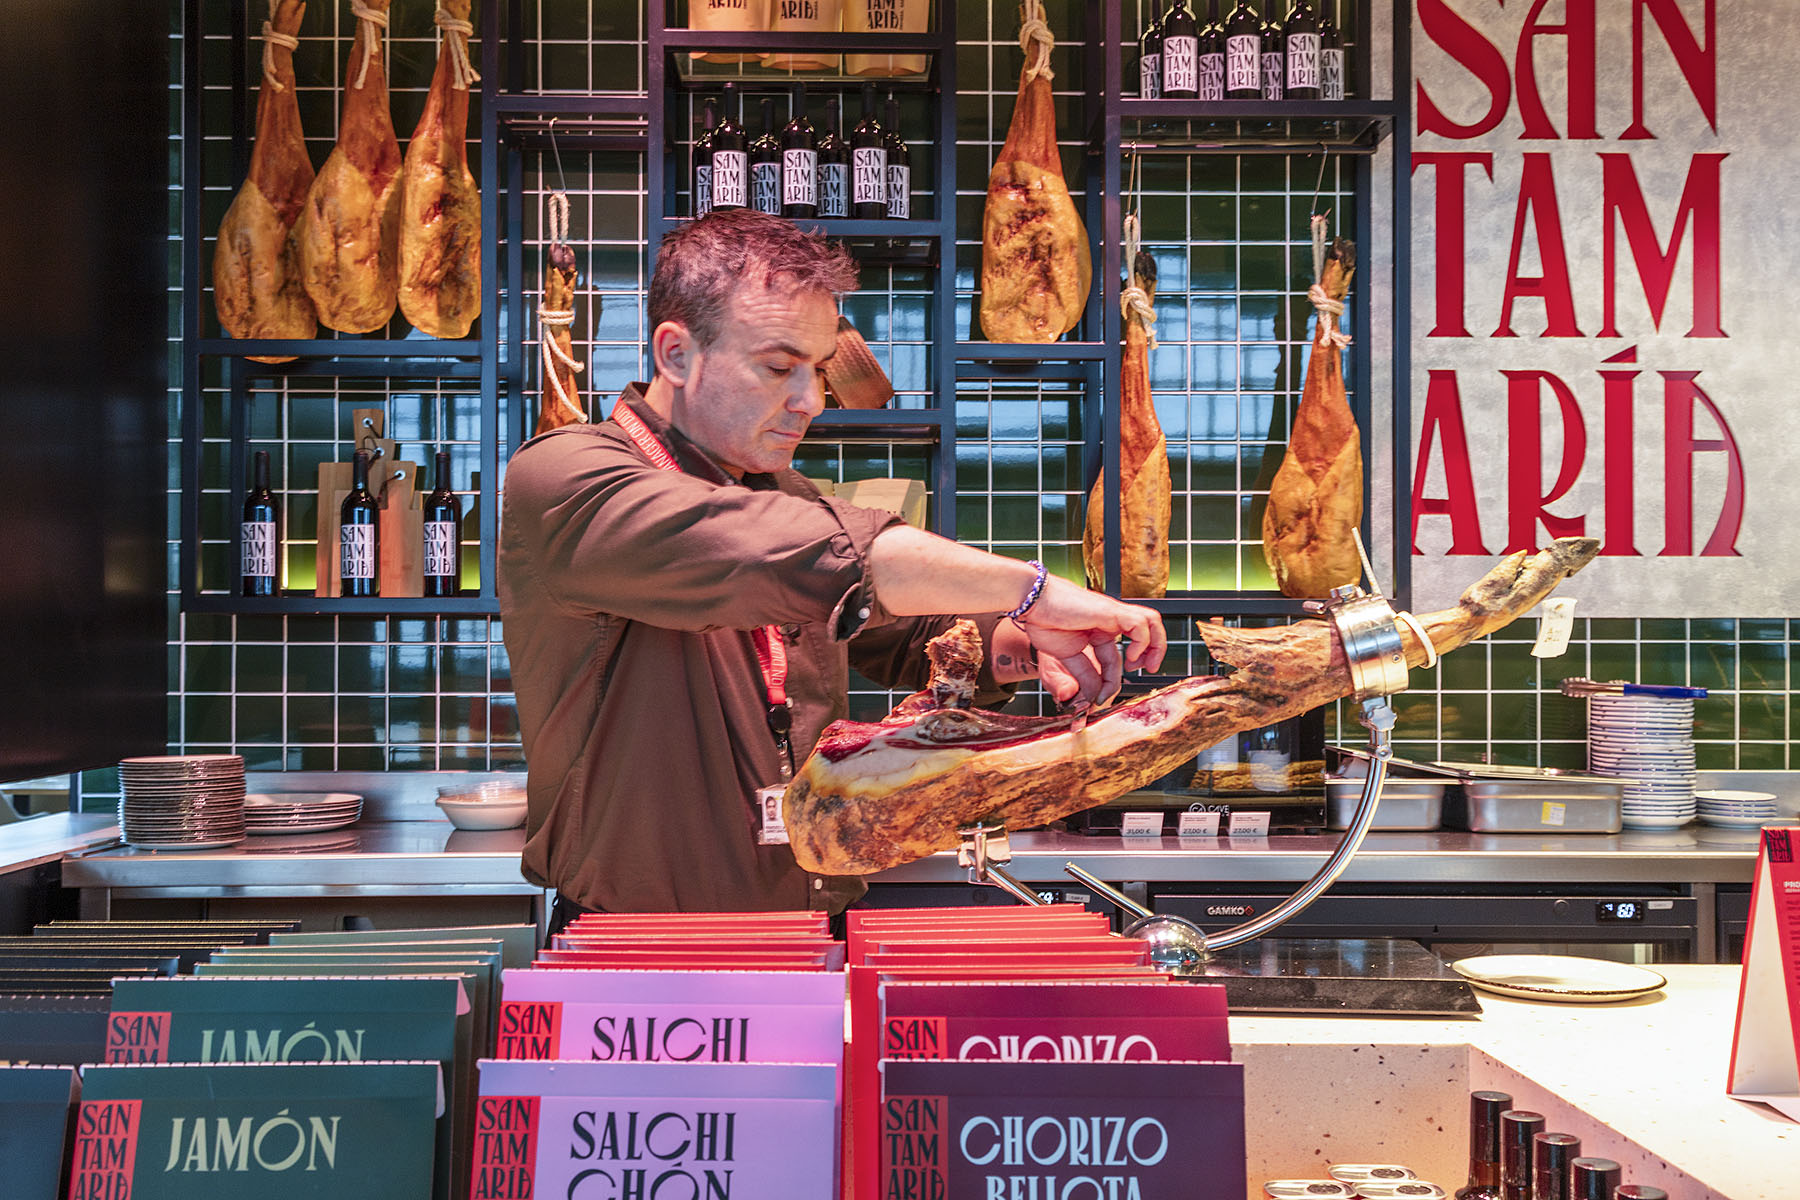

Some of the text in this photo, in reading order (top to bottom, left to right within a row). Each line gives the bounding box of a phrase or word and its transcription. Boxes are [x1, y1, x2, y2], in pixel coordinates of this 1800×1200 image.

[1166, 38, 1192, 55] SAN
[1229, 37, 1254, 55] SAN
[1290, 35, 1316, 52] SAN
[1166, 55, 1191, 72] TAM
[1228, 54, 1254, 71] TAM
[1290, 52, 1316, 69] TAM
[1417, 0, 1717, 140] SAN
[715, 153, 740, 170] SAN
[786, 152, 812, 168] SAN
[856, 150, 881, 167] SAN
[714, 170, 739, 187] TAM
[786, 168, 811, 185] TAM
[856, 167, 881, 183] TAM
[1411, 152, 1731, 338] TAM
[1411, 345, 1744, 557] ARÍA
[242, 524, 266, 540] SAN
[341, 526, 366, 543] SAN
[424, 524, 447, 540] SAN
[242, 541, 266, 557] TAM
[341, 543, 365, 559] TAM
[424, 541, 447, 557] TAM
[1207, 906, 1245, 916] GAMKO
[502, 1004, 555, 1034] SAN
[110, 1015, 162, 1046] SAN
[591, 1016, 750, 1062] SALCHI
[887, 1019, 939, 1051] SAN
[80, 1103, 133, 1135] SAN
[479, 1098, 532, 1131] SAN
[886, 1098, 939, 1131] SAN
[164, 1109, 341, 1173] JAMÓN
[570, 1111, 736, 1162] SALCHI
[959, 1115, 1168, 1167] CHORIZO
[78, 1137, 129, 1170] TAM
[478, 1132, 529, 1165] TAM
[886, 1133, 938, 1166] TAM
